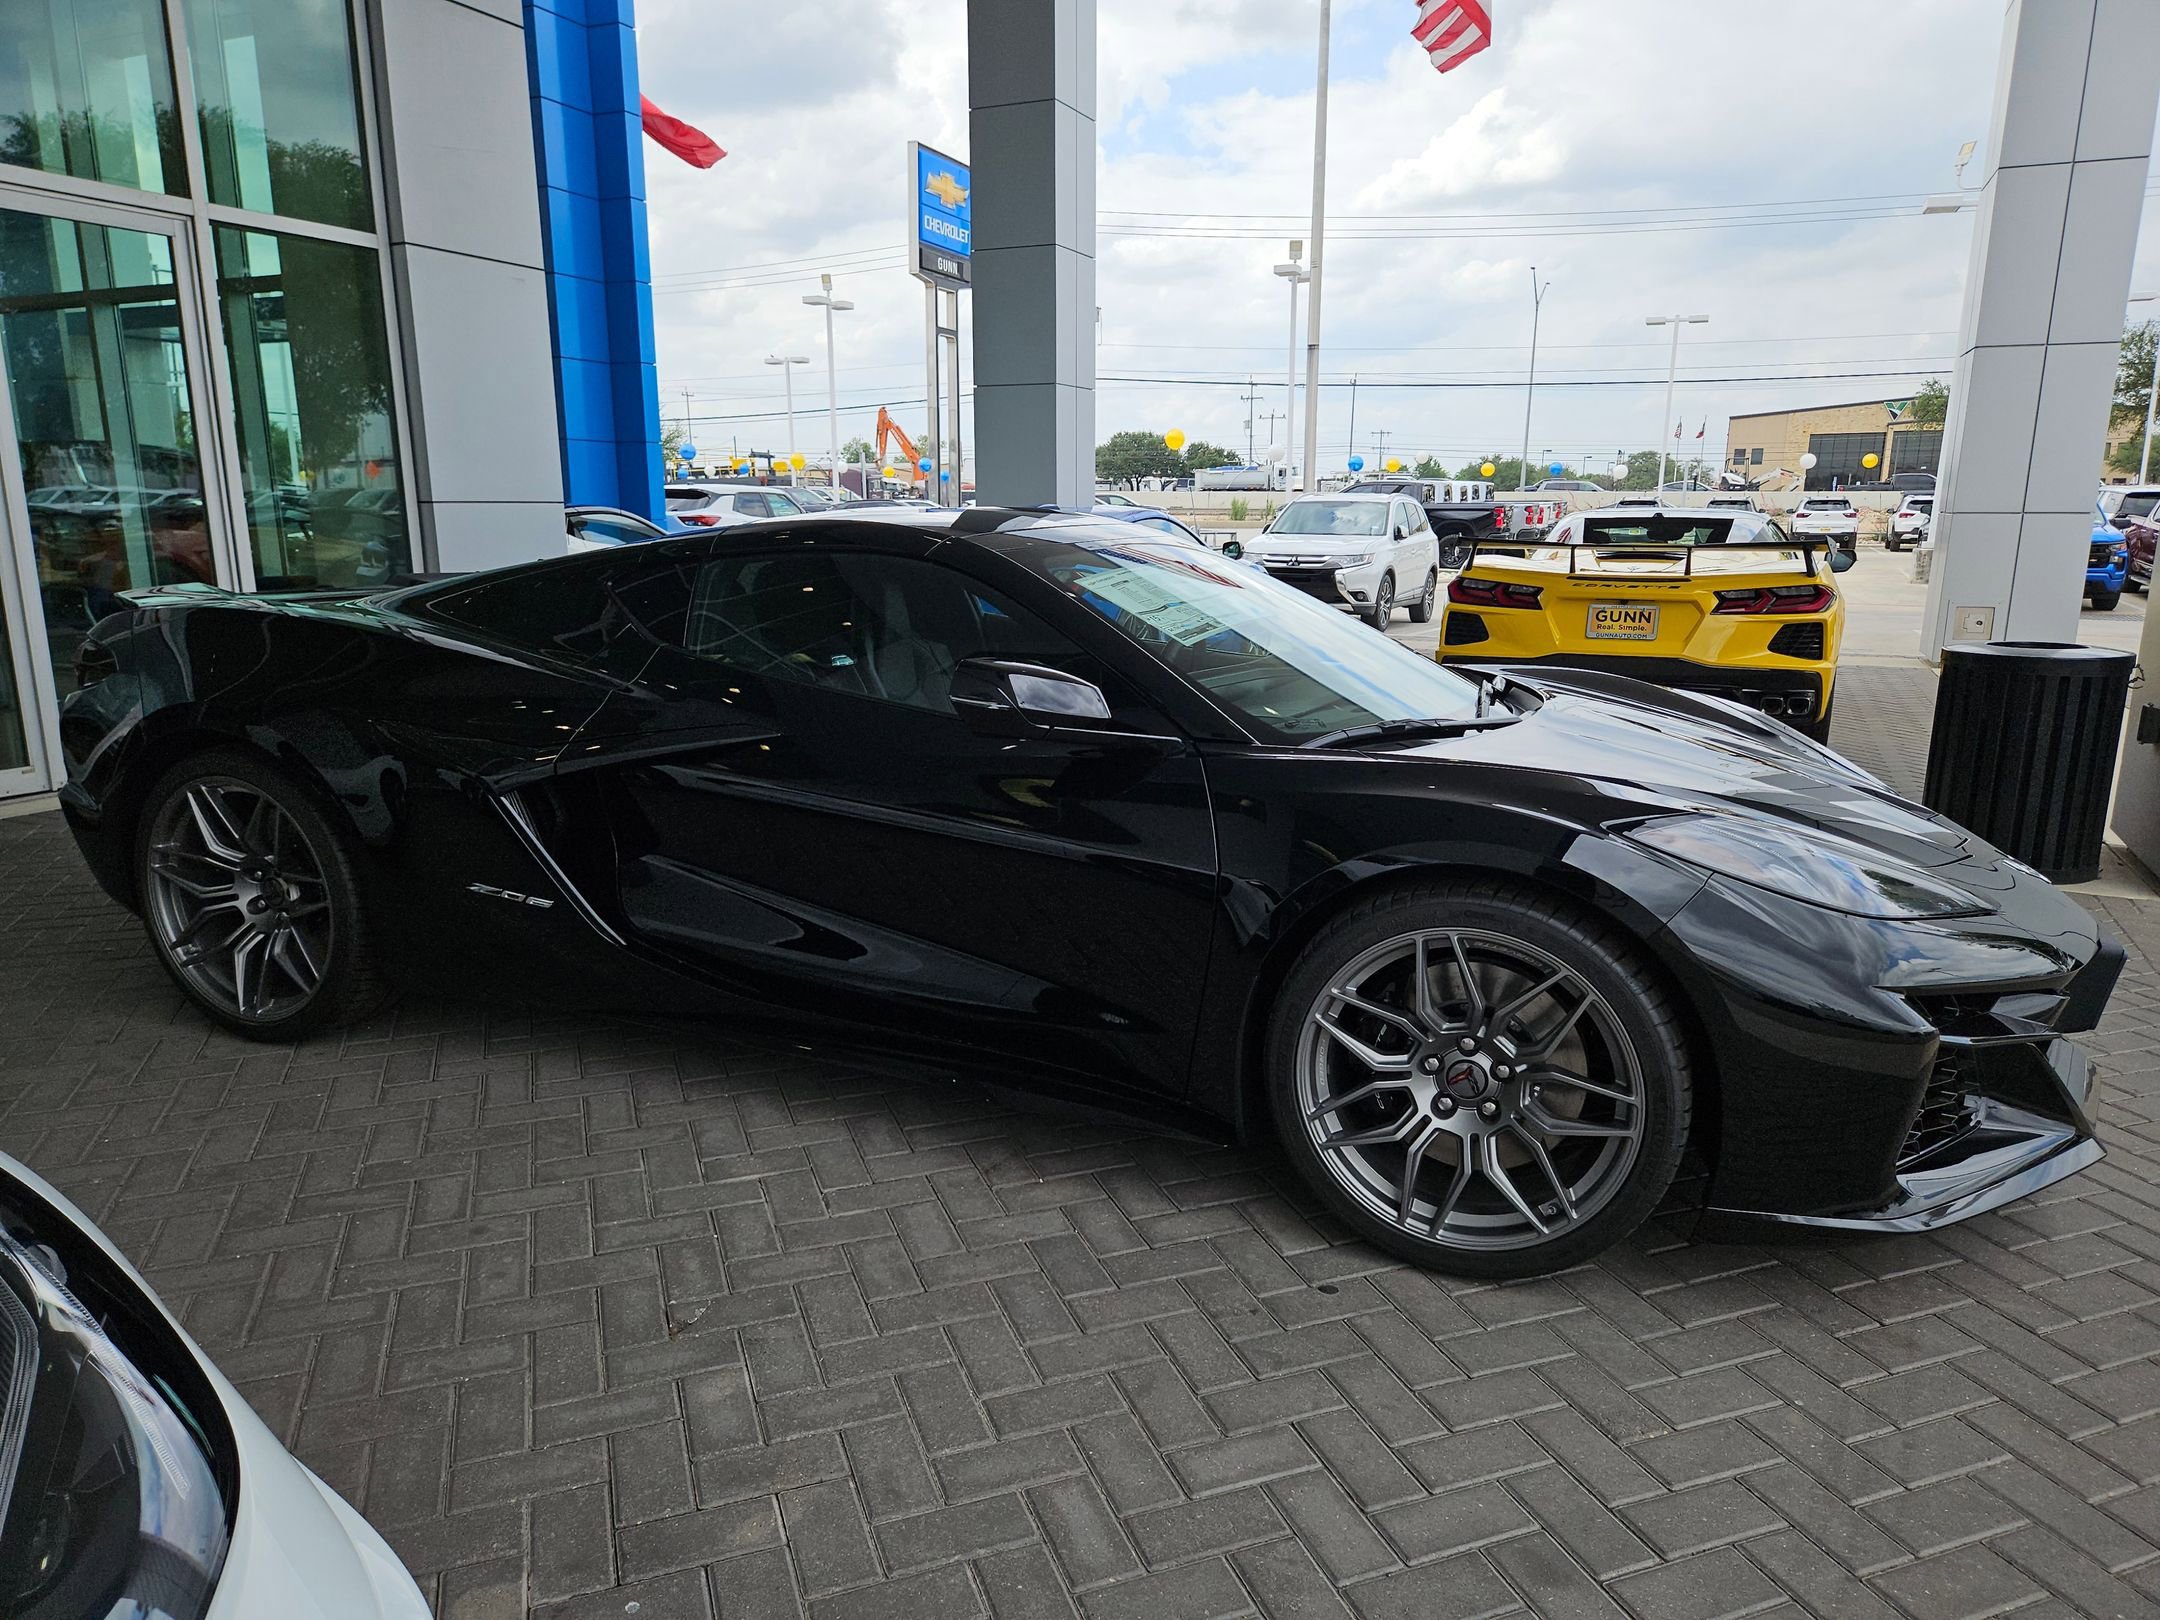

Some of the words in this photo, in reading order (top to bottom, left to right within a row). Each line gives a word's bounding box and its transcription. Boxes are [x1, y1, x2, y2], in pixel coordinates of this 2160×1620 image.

[924, 214, 970, 243] CHEVROLET
[937, 257, 958, 275] GUNN
[1595, 609, 1652, 624] GUNN
[1618, 624, 1647, 632] Simple.
[465, 882, 555, 909] Z06
